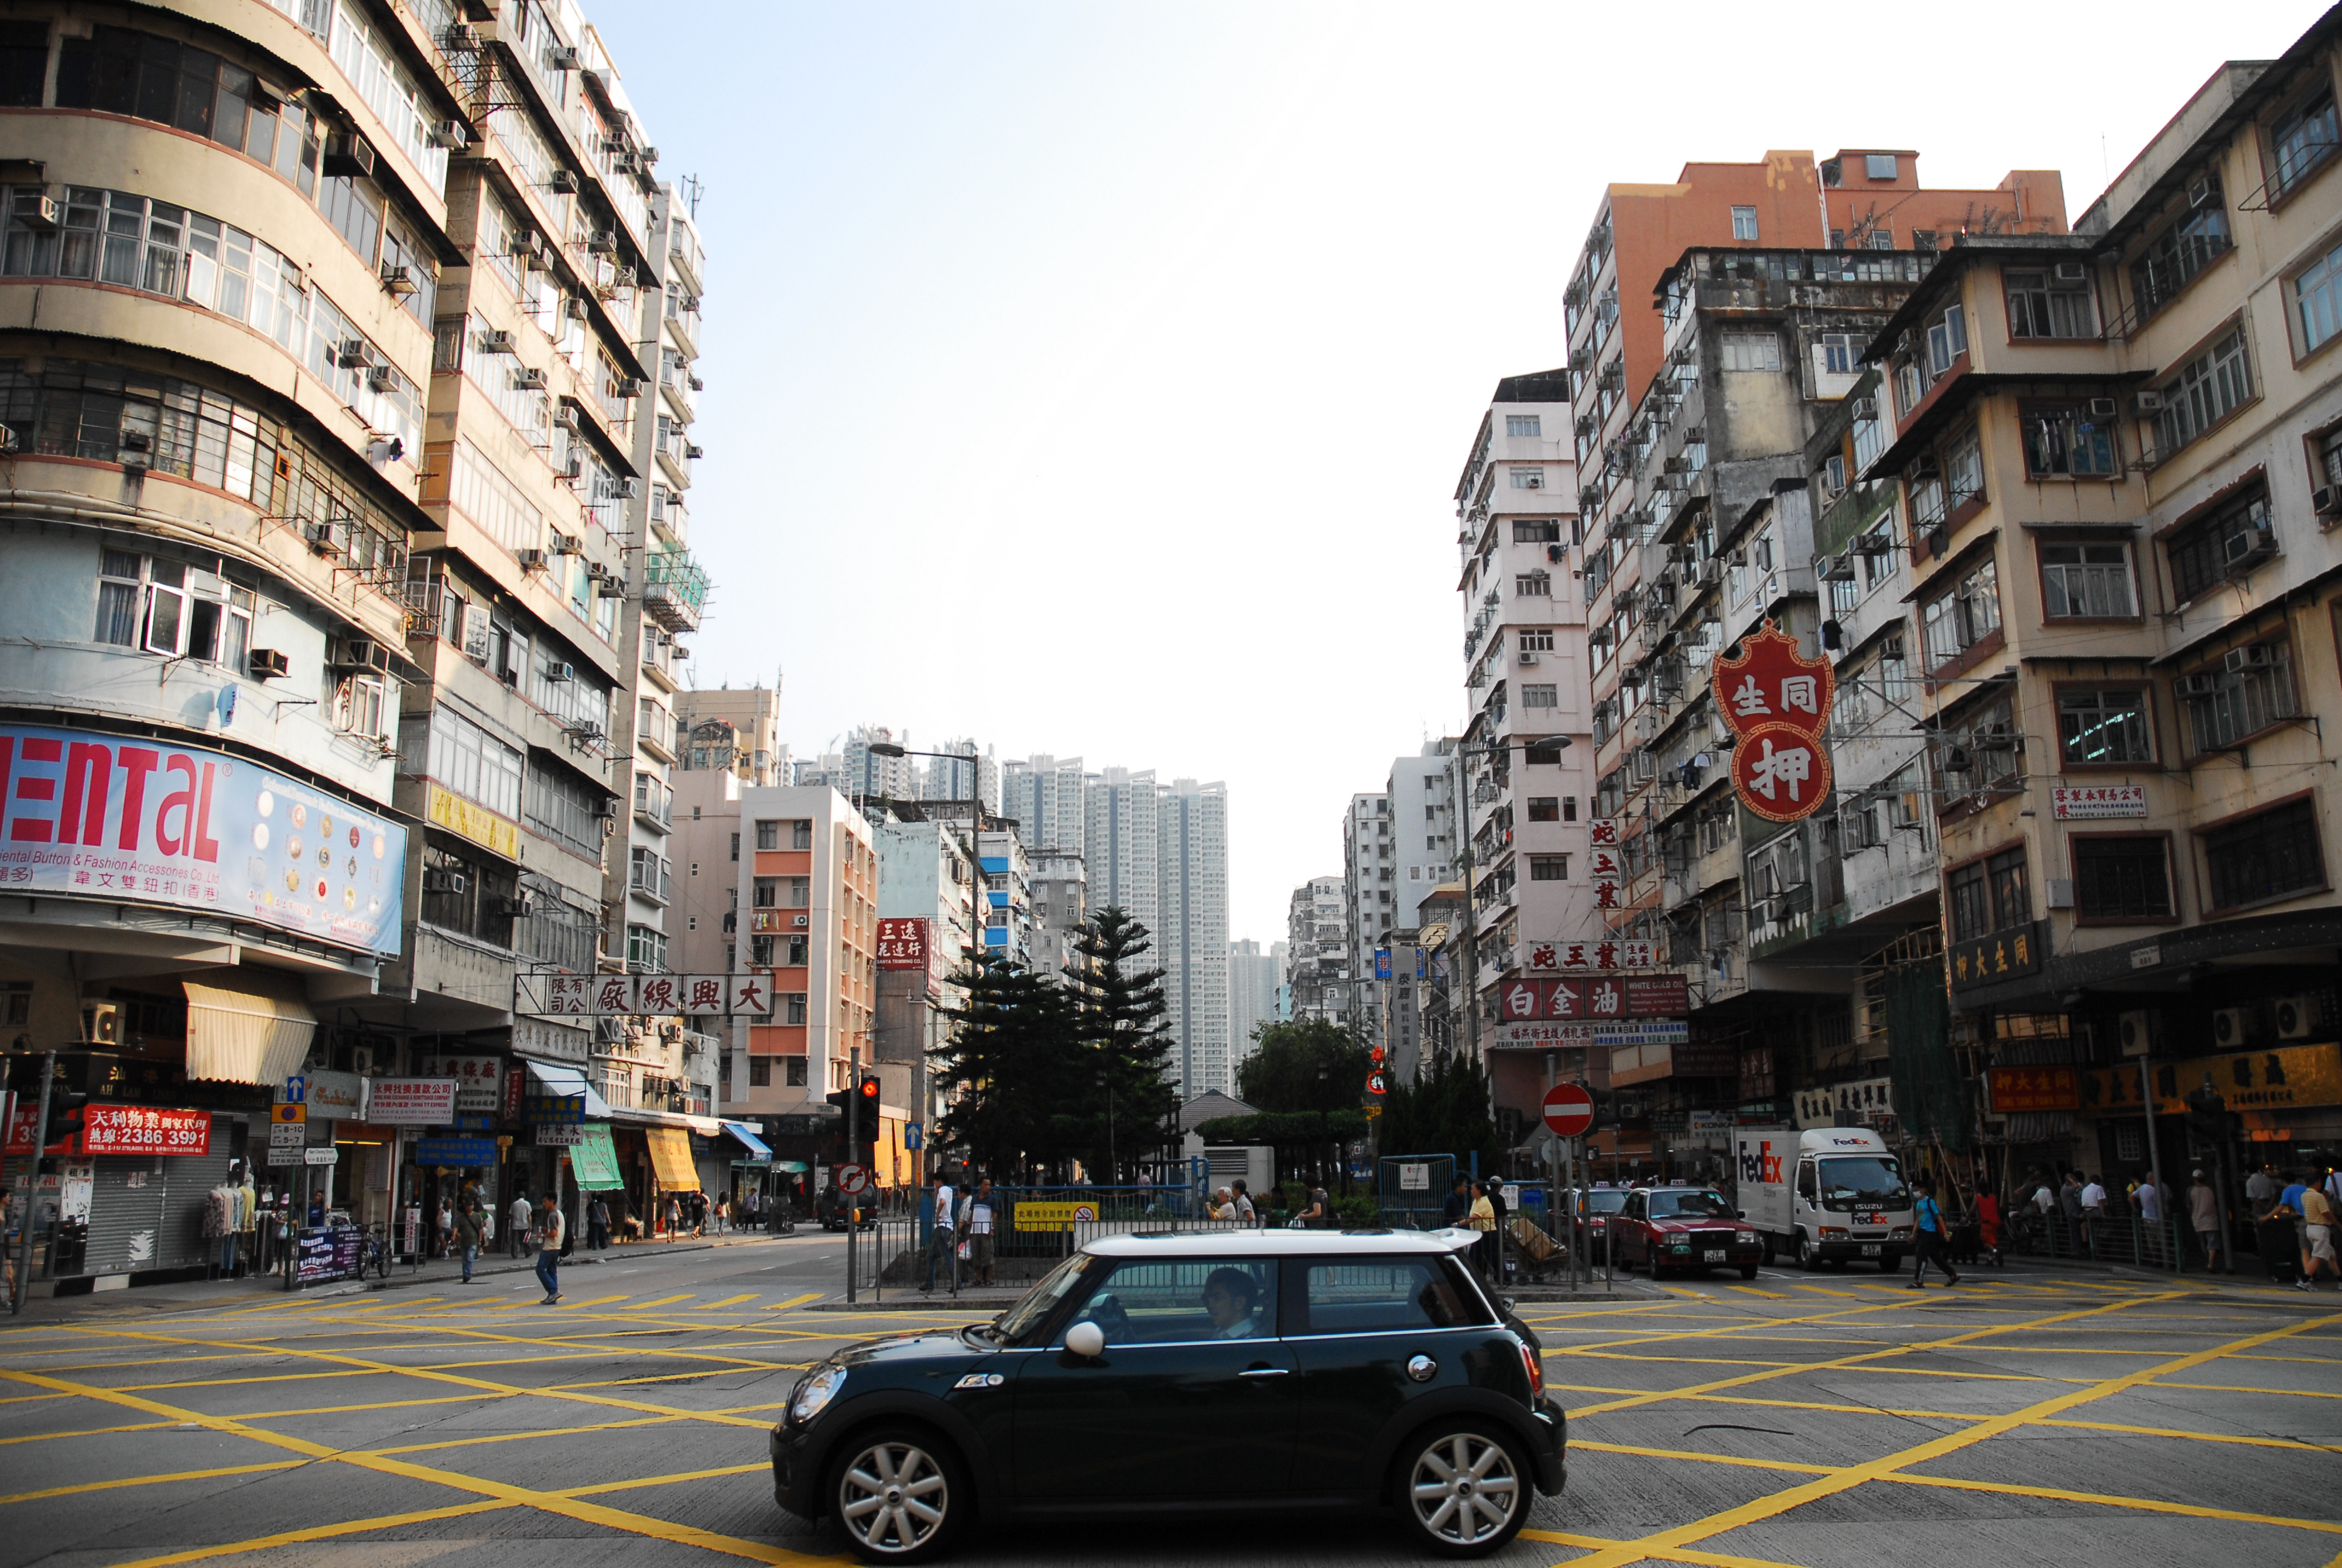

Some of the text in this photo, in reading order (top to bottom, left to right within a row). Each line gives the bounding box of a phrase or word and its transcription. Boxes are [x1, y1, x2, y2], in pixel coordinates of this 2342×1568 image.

[1749, 738, 1811, 802] 押
[33, 851, 70, 865] Button
[74, 856, 81, 865] &
[84, 855, 126, 870] Fashion
[129, 861, 188, 879] Accessories
[1532, 942, 1619, 969] 蛇王業
[1506, 981, 1619, 1016] 白金油
[100, 1085, 113, 1095] AH
[91, 1111, 159, 1128] 天利物業
[169, 1130, 206, 1145] 3991
[1740, 1141, 1783, 1183] FedEx
[1851, 1213, 1887, 1225] FedEx
